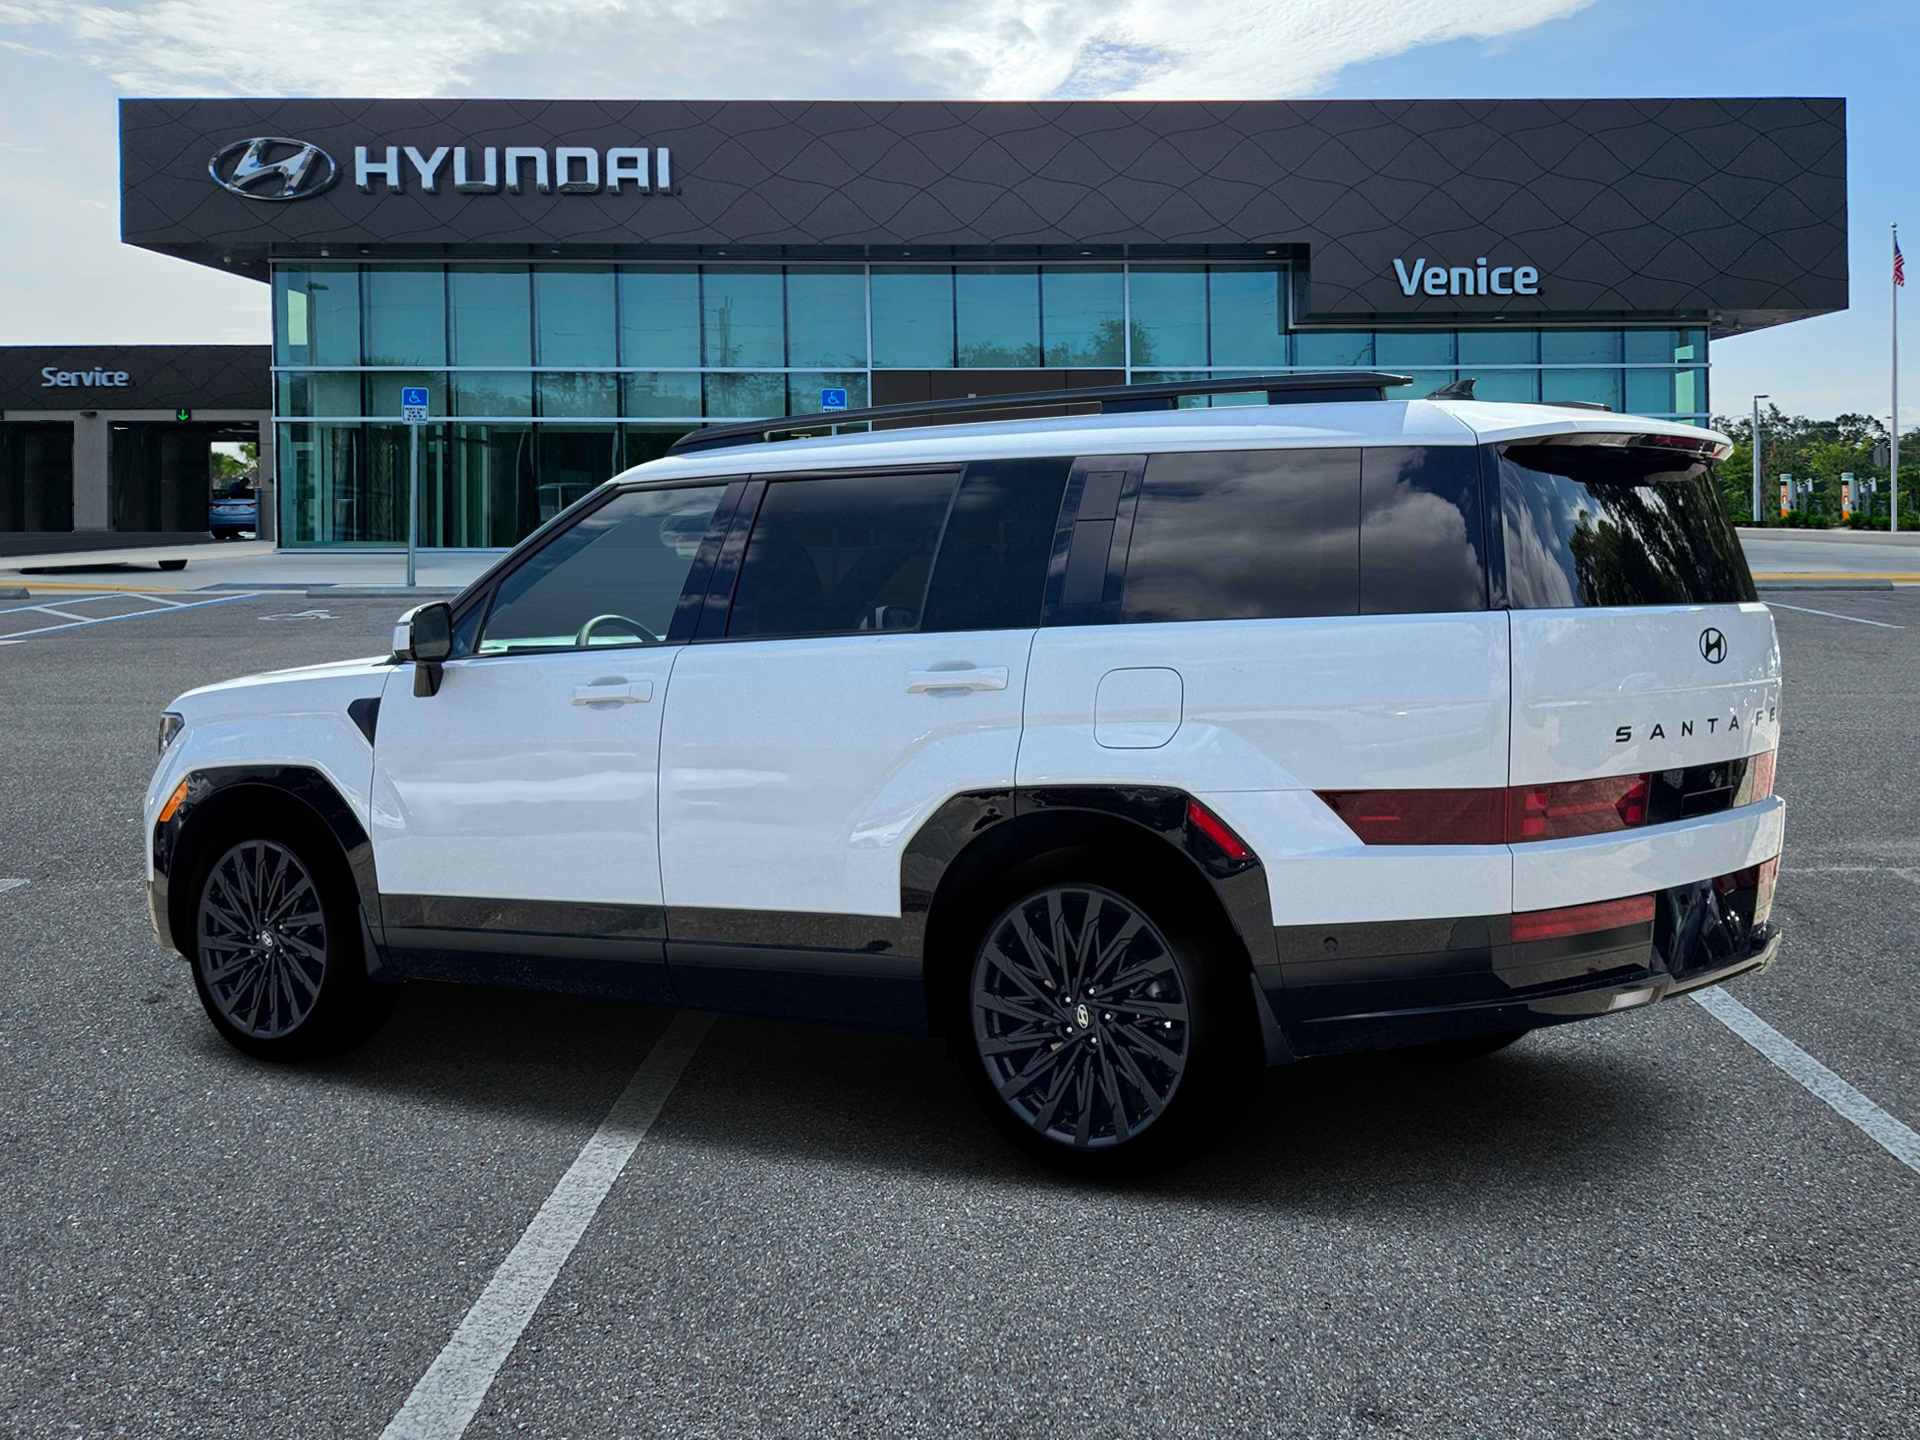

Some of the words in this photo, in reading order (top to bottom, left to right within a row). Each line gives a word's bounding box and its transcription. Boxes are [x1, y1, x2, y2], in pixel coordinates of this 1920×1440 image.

[354, 145, 673, 194] HYUNDAI
[1392, 256, 1539, 296] Venice
[41, 366, 130, 388] Service
[1615, 715, 1740, 743] SANTA
[1755, 707, 1776, 726] FE
